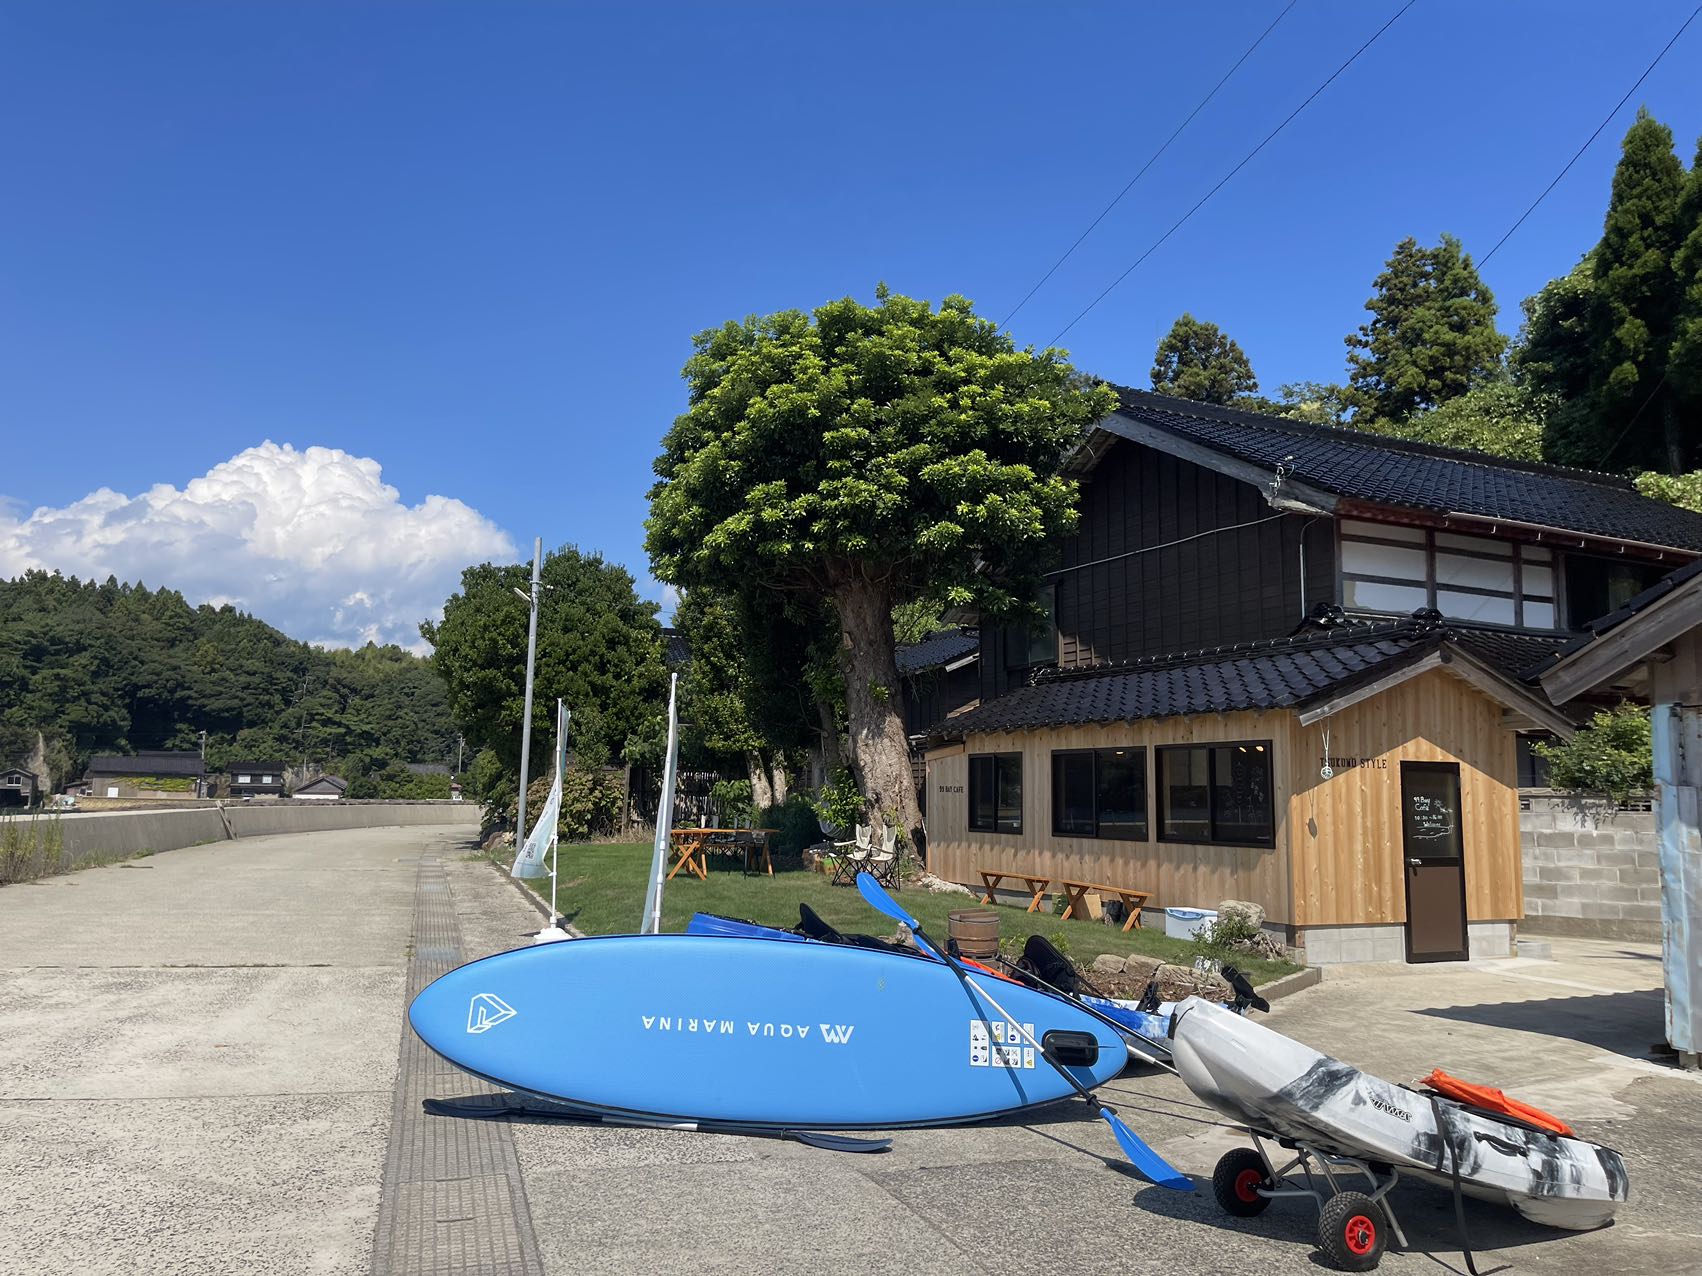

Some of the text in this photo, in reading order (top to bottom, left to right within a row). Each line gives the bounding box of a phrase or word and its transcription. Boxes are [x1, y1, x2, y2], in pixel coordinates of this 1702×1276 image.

[1360, 758, 1387, 769] STYLE
[641, 1015, 735, 1035] MARINA
[747, 1021, 810, 1039] AQUA
